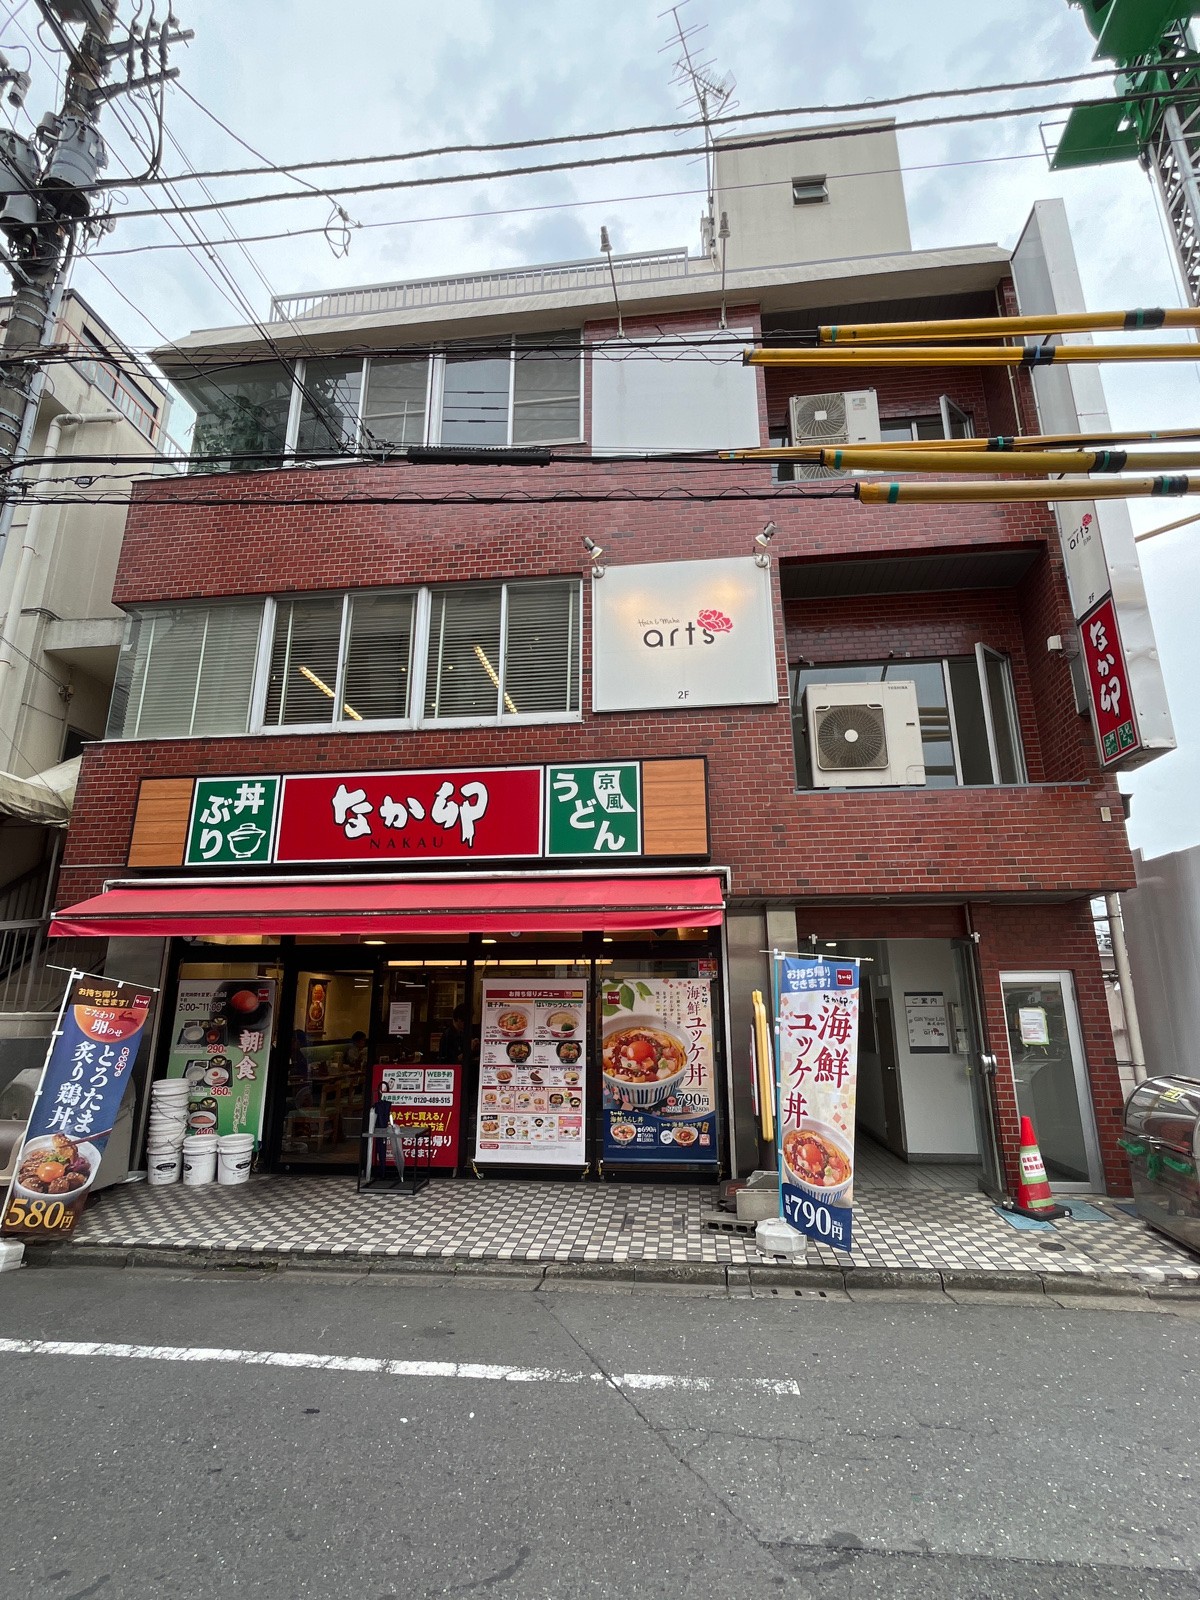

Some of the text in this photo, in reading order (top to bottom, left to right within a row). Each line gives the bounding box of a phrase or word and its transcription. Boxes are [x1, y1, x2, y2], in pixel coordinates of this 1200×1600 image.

[638, 618, 655, 627] Hair
[659, 617, 680, 626] Make
[643, 622, 715, 648] arts
[1089, 620, 1122, 718] なか卯
[677, 690, 690, 700] 2F
[553, 772, 626, 851] うどん
[598, 773, 624, 810] 京風
[199, 782, 266, 860] 丼ぶり
[332, 781, 489, 848] なか卯
[369, 836, 444, 849] NAKAU
[78, 988, 119, 998] お持ち帰り
[786, 965, 831, 980] お持ち帰り
[84, 1008, 116, 1020] こだわり
[91, 1019, 124, 1037] 卵のせ
[235, 1029, 262, 1081] 朝食
[685, 986, 708, 1087] 海鮮ユッケ丼
[813, 1005, 853, 1089] 海鮮
[45, 1040, 97, 1130] 炙り鶏丼
[74, 1045, 115, 1134] とろたま
[782, 1012, 817, 1129] ユッケ丼
[676, 1092, 710, 1106] 790円
[5, 1198, 74, 1229] 580円
[790, 1194, 843, 1241] 790円
